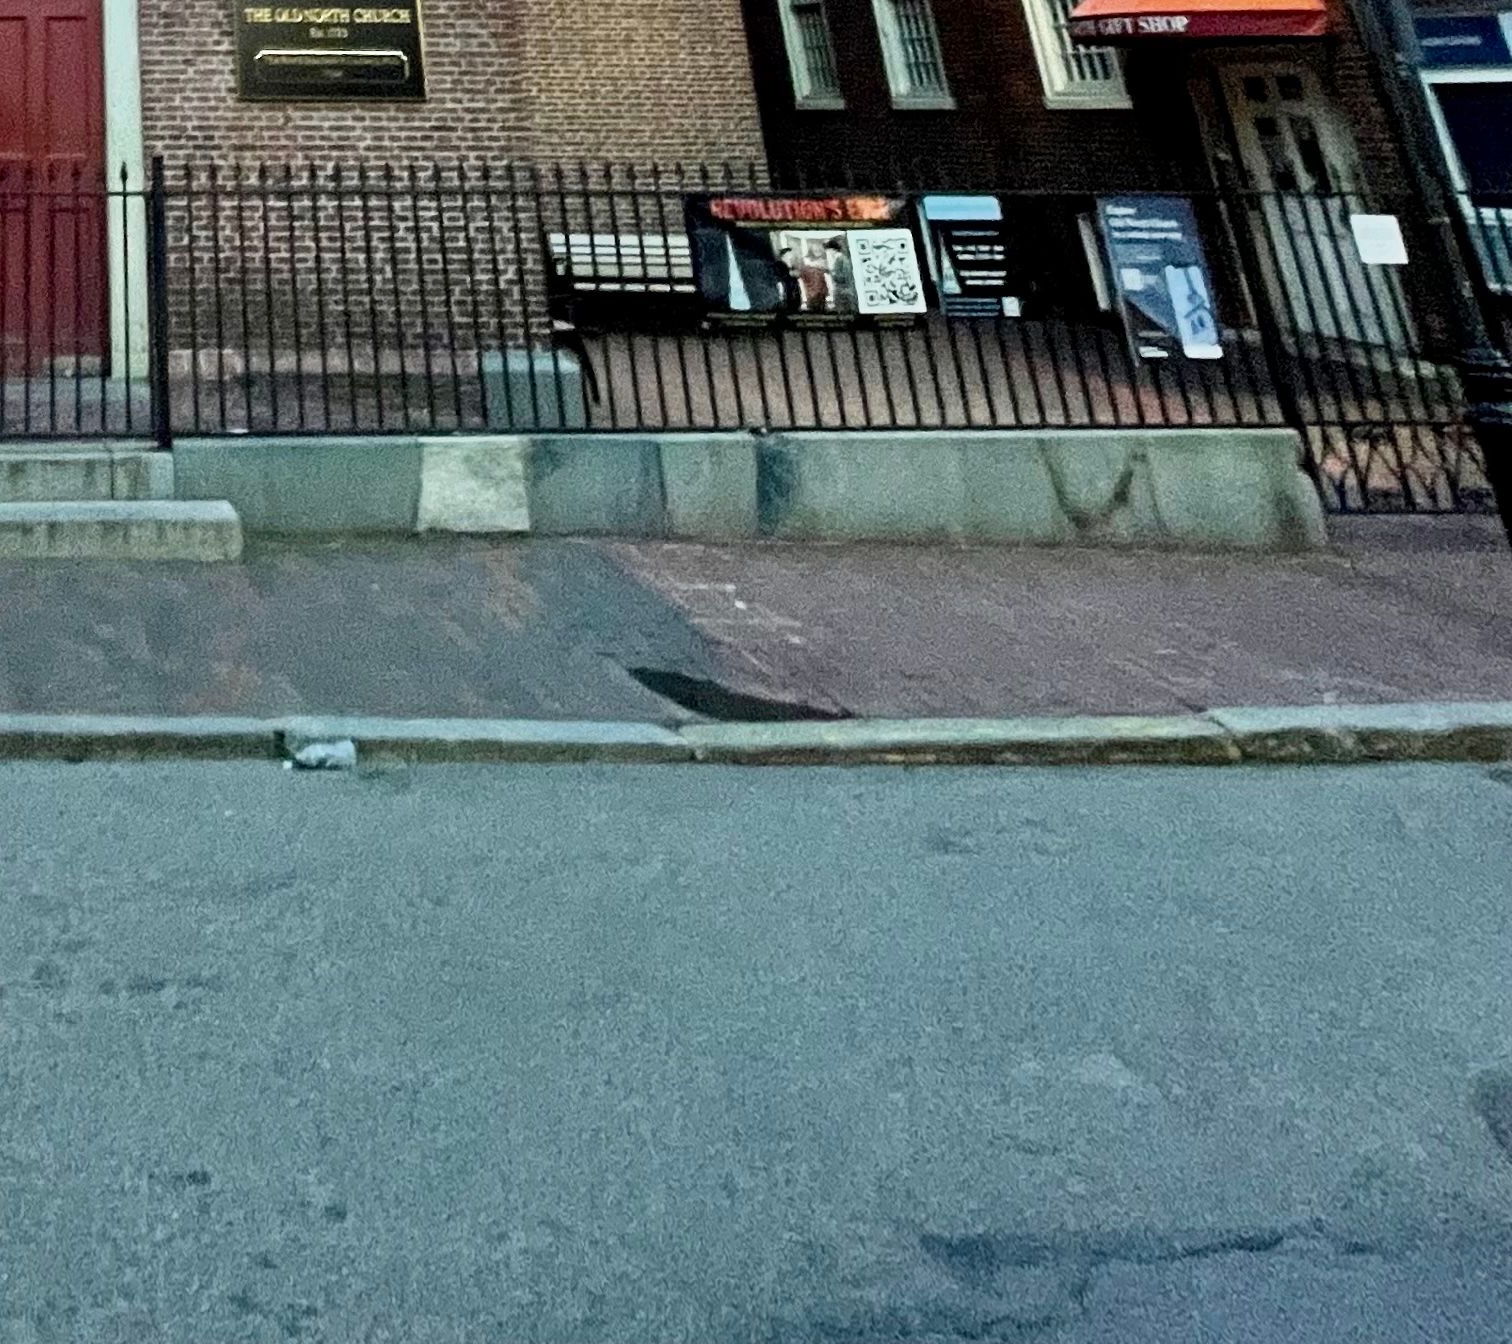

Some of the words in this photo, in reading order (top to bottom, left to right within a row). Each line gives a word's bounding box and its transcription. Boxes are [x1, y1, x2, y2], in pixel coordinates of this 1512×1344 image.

[243, 7, 272, 23] THE
[274, 7, 303, 23] OLD
[303, 7, 350, 23] NORTH
[353, 8, 411, 23] CHURCH
[1137, 15, 1188, 32] SHOP
